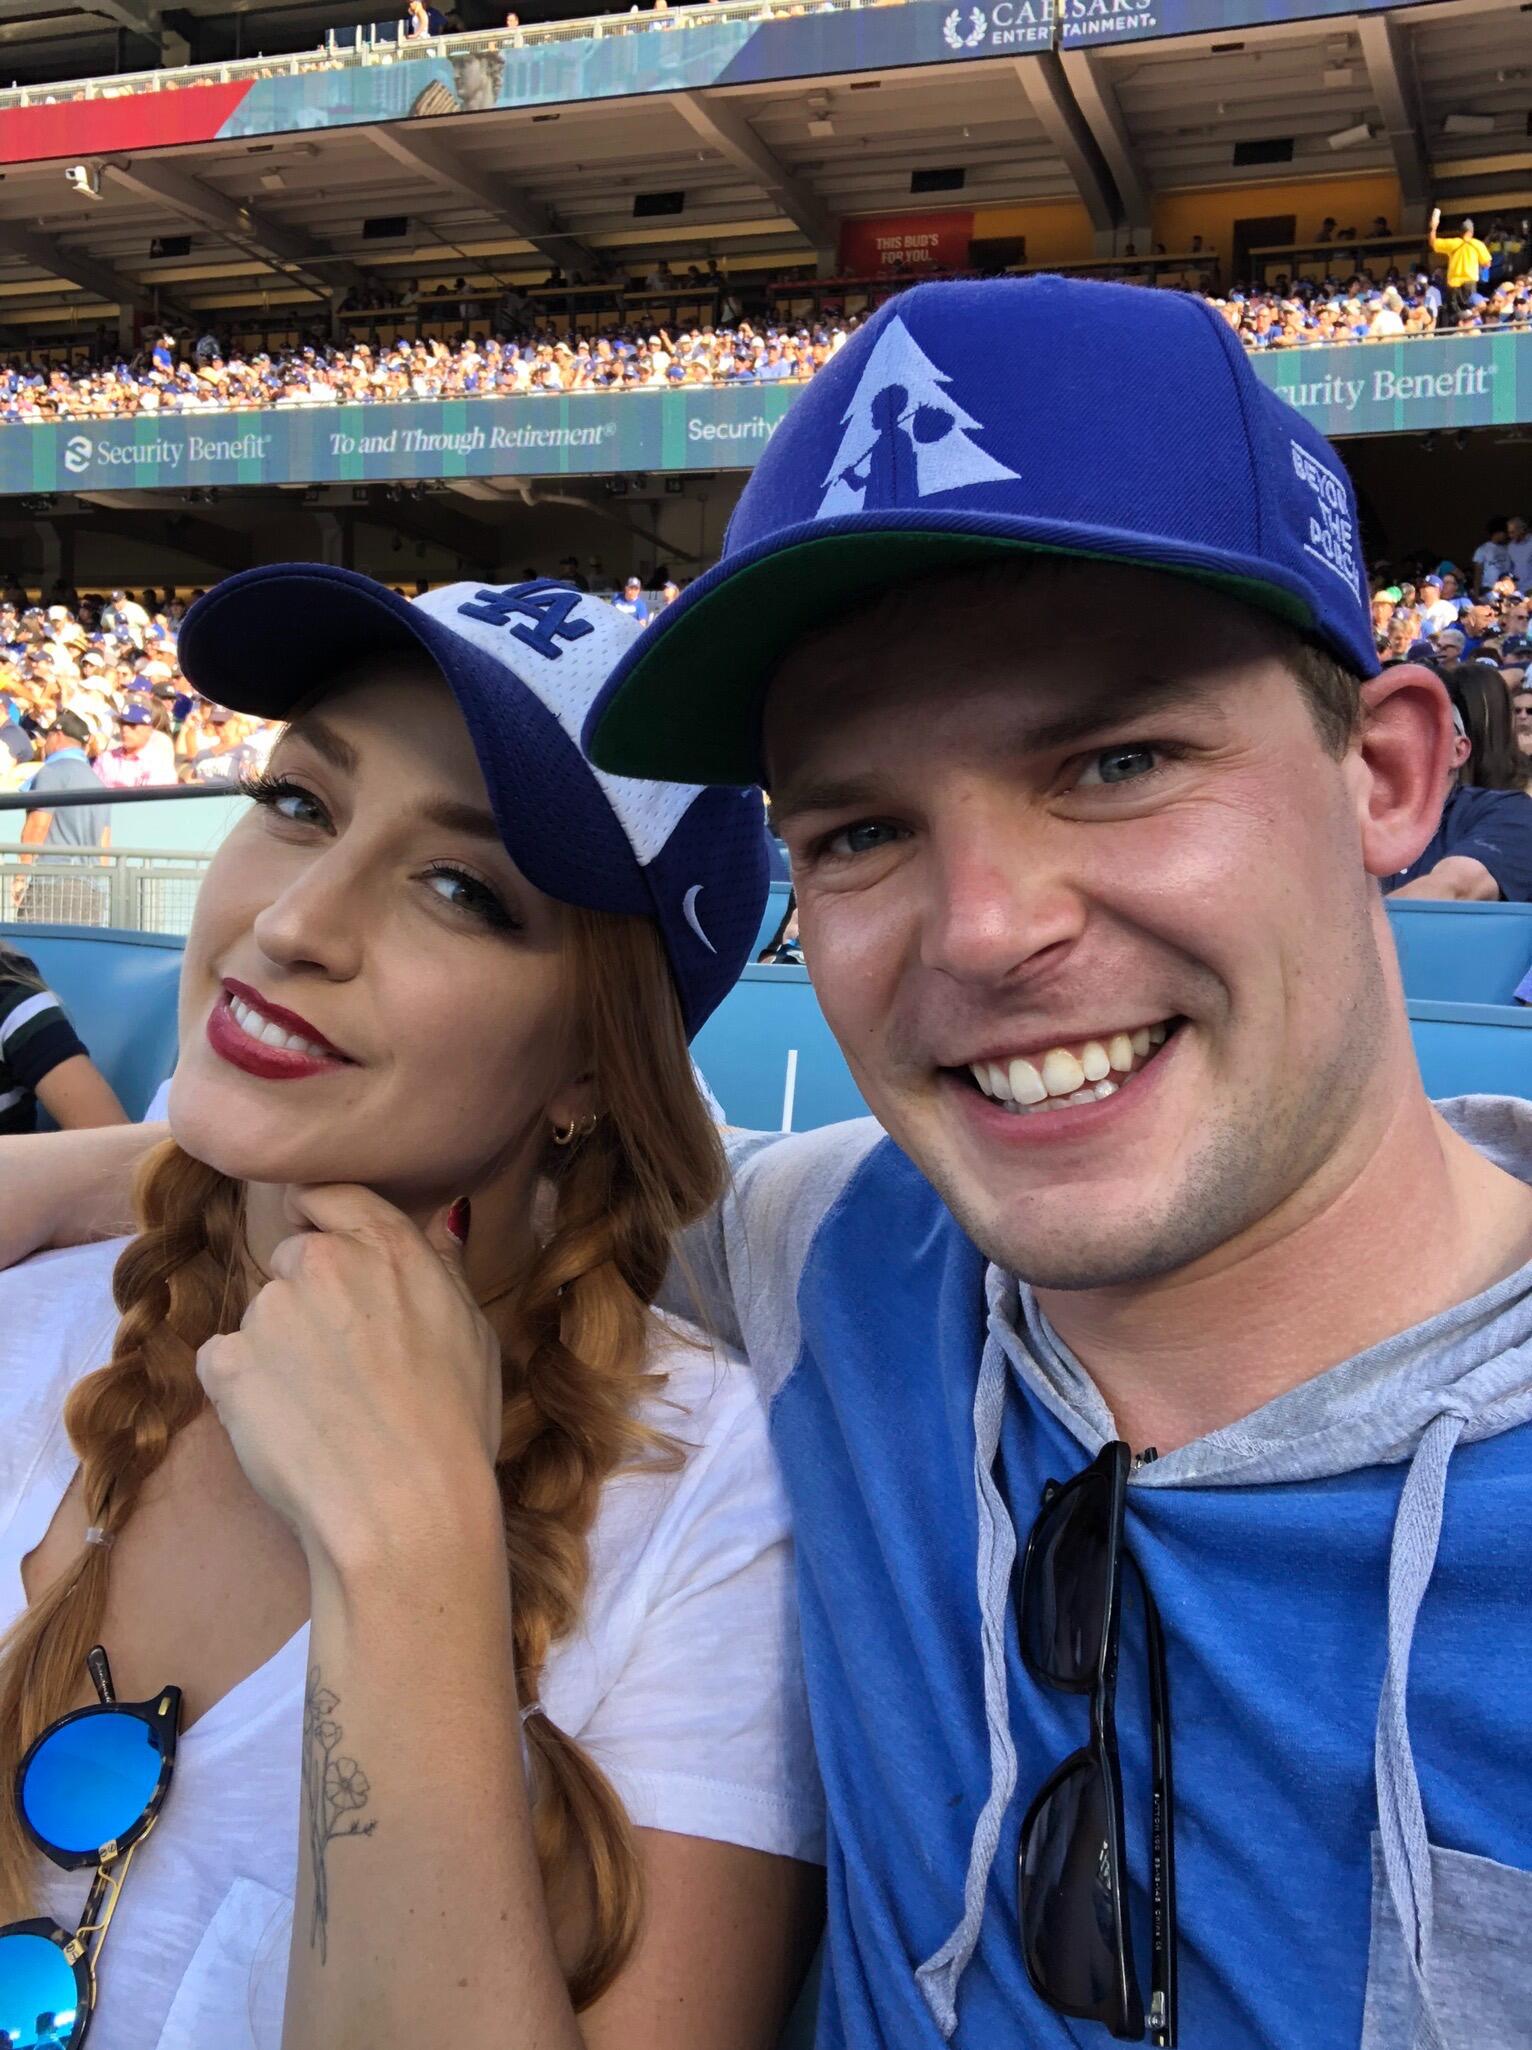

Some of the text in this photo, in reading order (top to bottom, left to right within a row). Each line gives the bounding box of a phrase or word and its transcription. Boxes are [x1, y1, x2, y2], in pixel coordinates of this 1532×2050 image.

[876, 233, 939, 250] THIS BUD'S
[881, 251, 903, 264] FOR
[1273, 374, 1366, 411] urity
[330, 433, 355, 455] To
[358, 429, 398, 453] and
[401, 426, 485, 456] Through
[688, 416, 785, 442] Security
[97, 437, 184, 469] Security
[1318, 496, 1352, 552] THE
